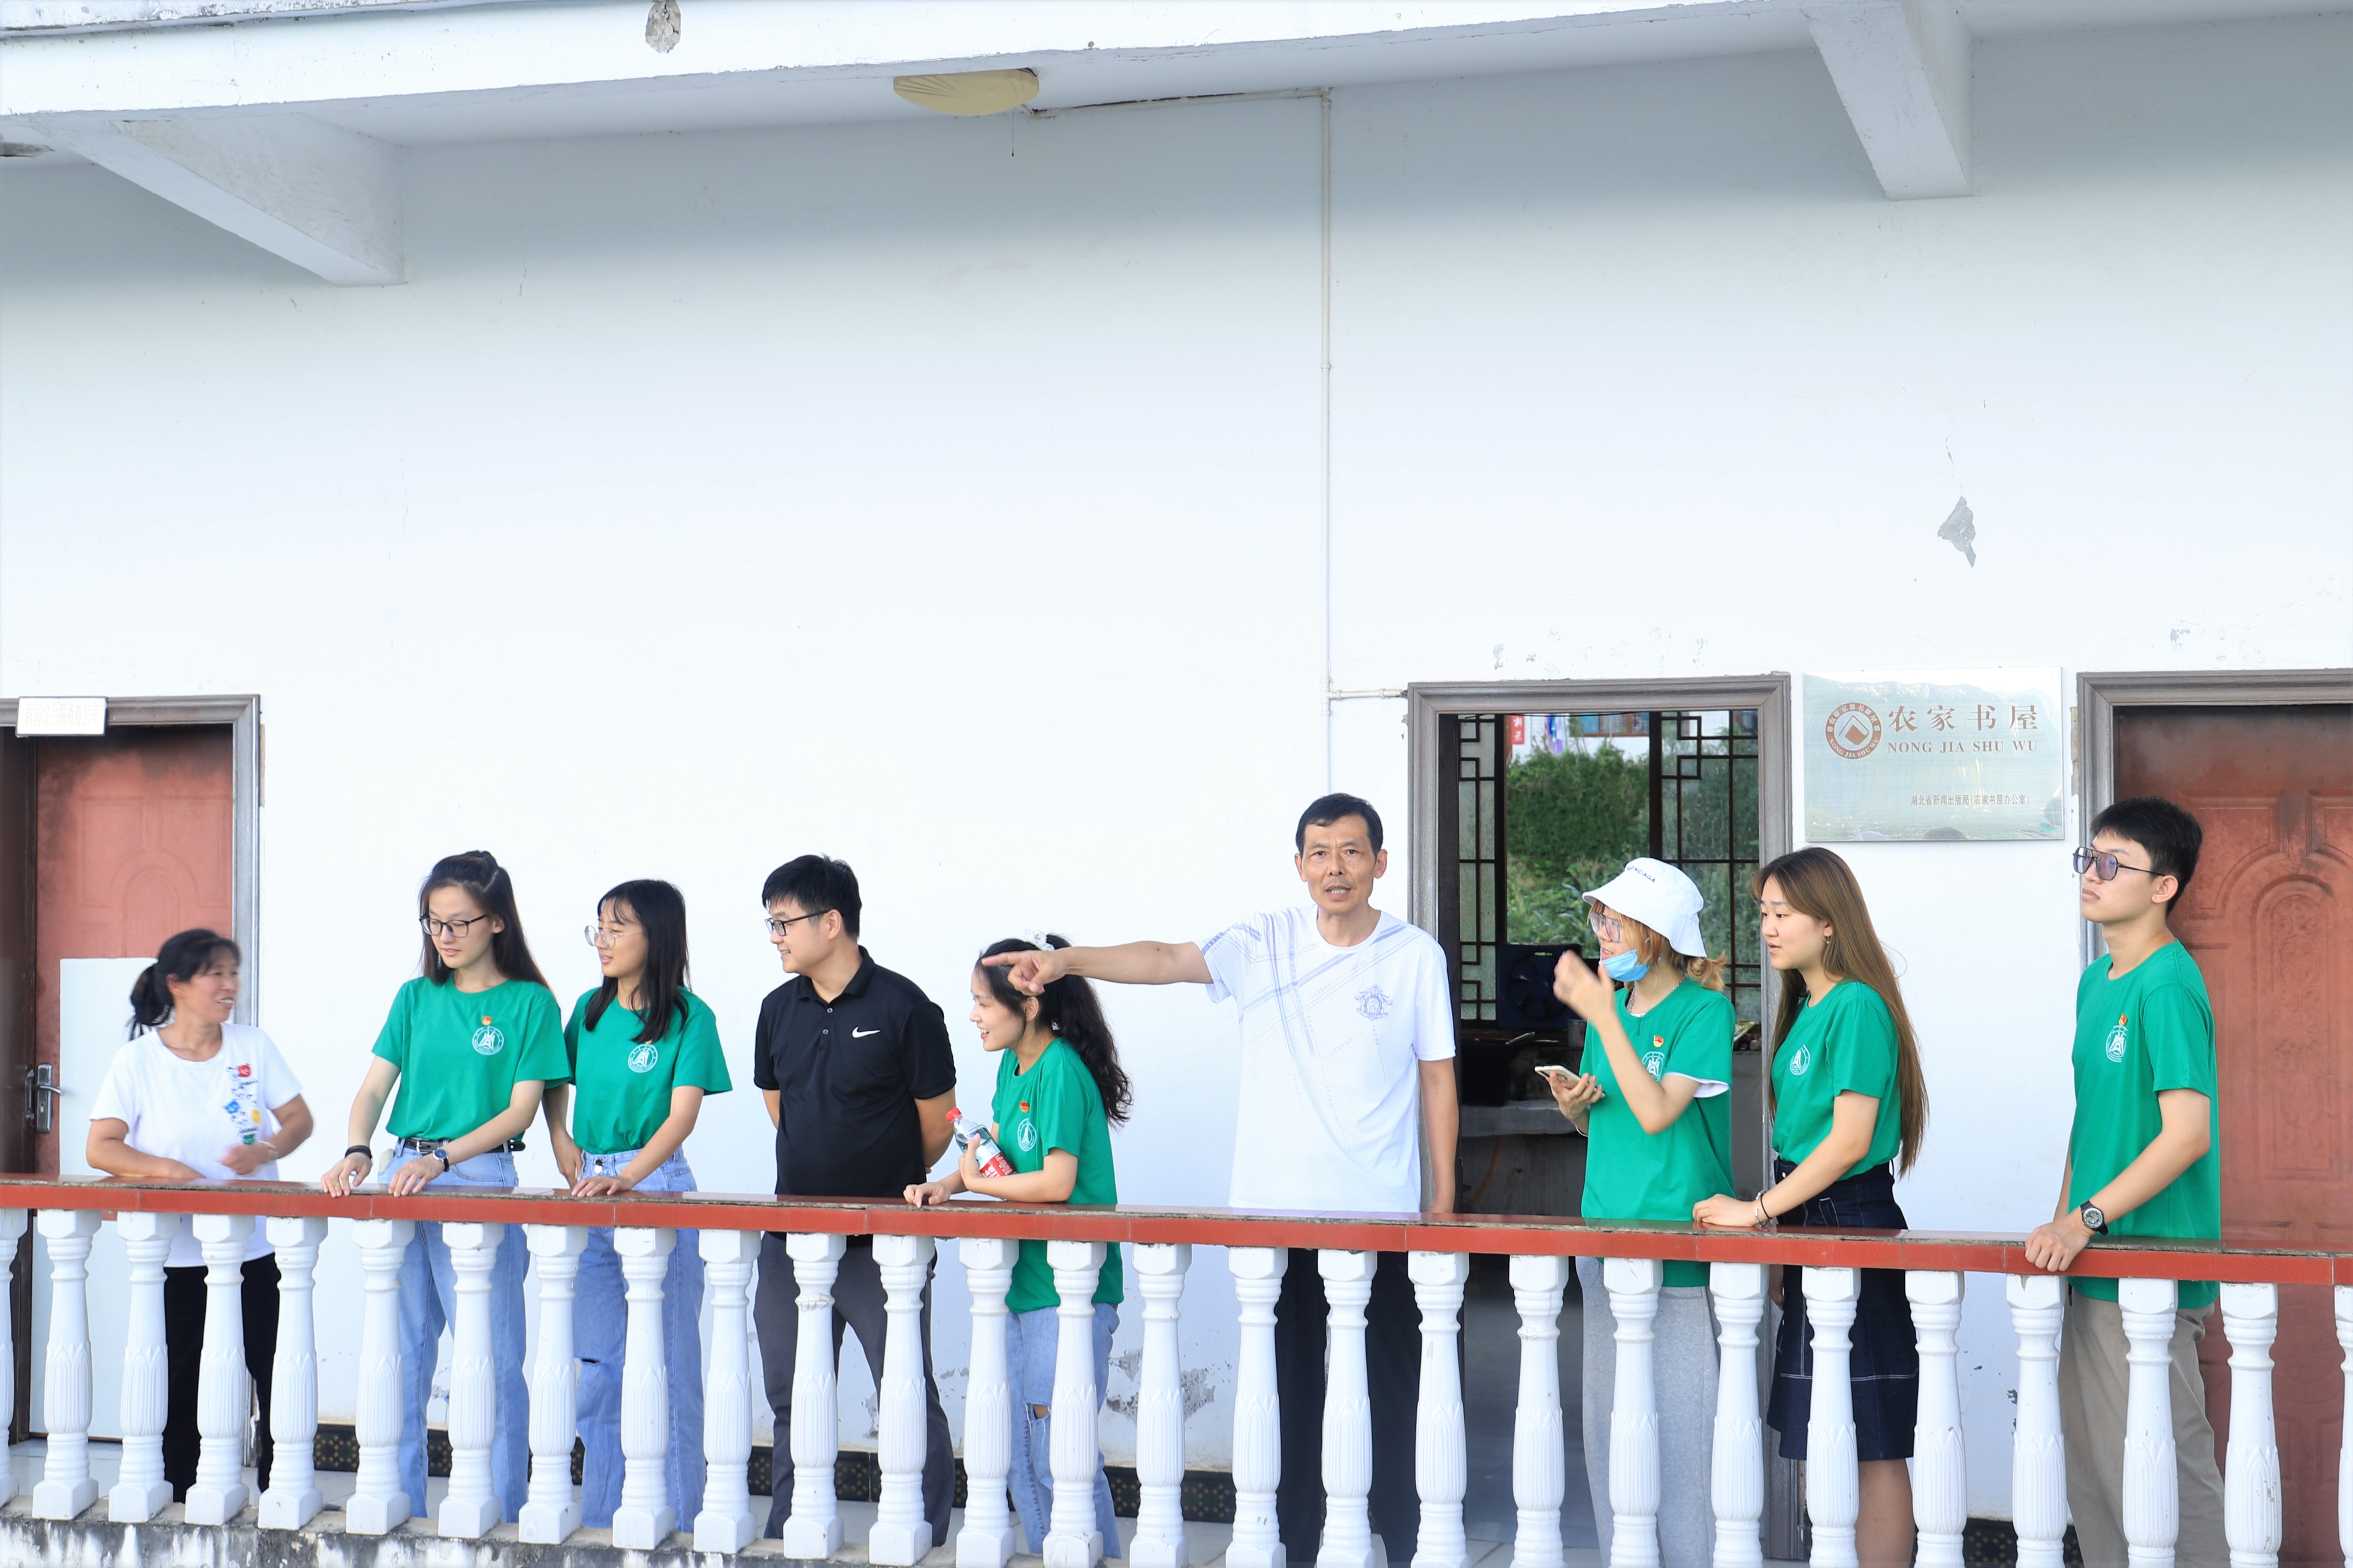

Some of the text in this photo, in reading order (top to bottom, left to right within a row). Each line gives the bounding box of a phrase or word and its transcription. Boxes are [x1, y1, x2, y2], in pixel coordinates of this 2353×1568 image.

[1888, 704, 2039, 733] 农家书屋
[1829, 738, 1844, 755] NONG
[1857, 747, 1870, 757] SHU
[1870, 737, 1879, 748] WU
[1888, 740, 2038, 754] NONG JIA SHU WU
[1911, 794, 2030, 805] 湖北省新闻出版局(农家书屋办公室)
[1349, 959, 1367, 973] TREND
[1257, 983, 1274, 995] TREND
[1314, 983, 1332, 997] TREND
[1305, 1011, 1314, 1033] TREND
[1371, 1024, 1380, 1046] TREND
[1334, 1037, 1353, 1052] TREND
[1292, 1073, 1301, 1095] TREND
[1325, 1085, 1334, 1107] TREND
